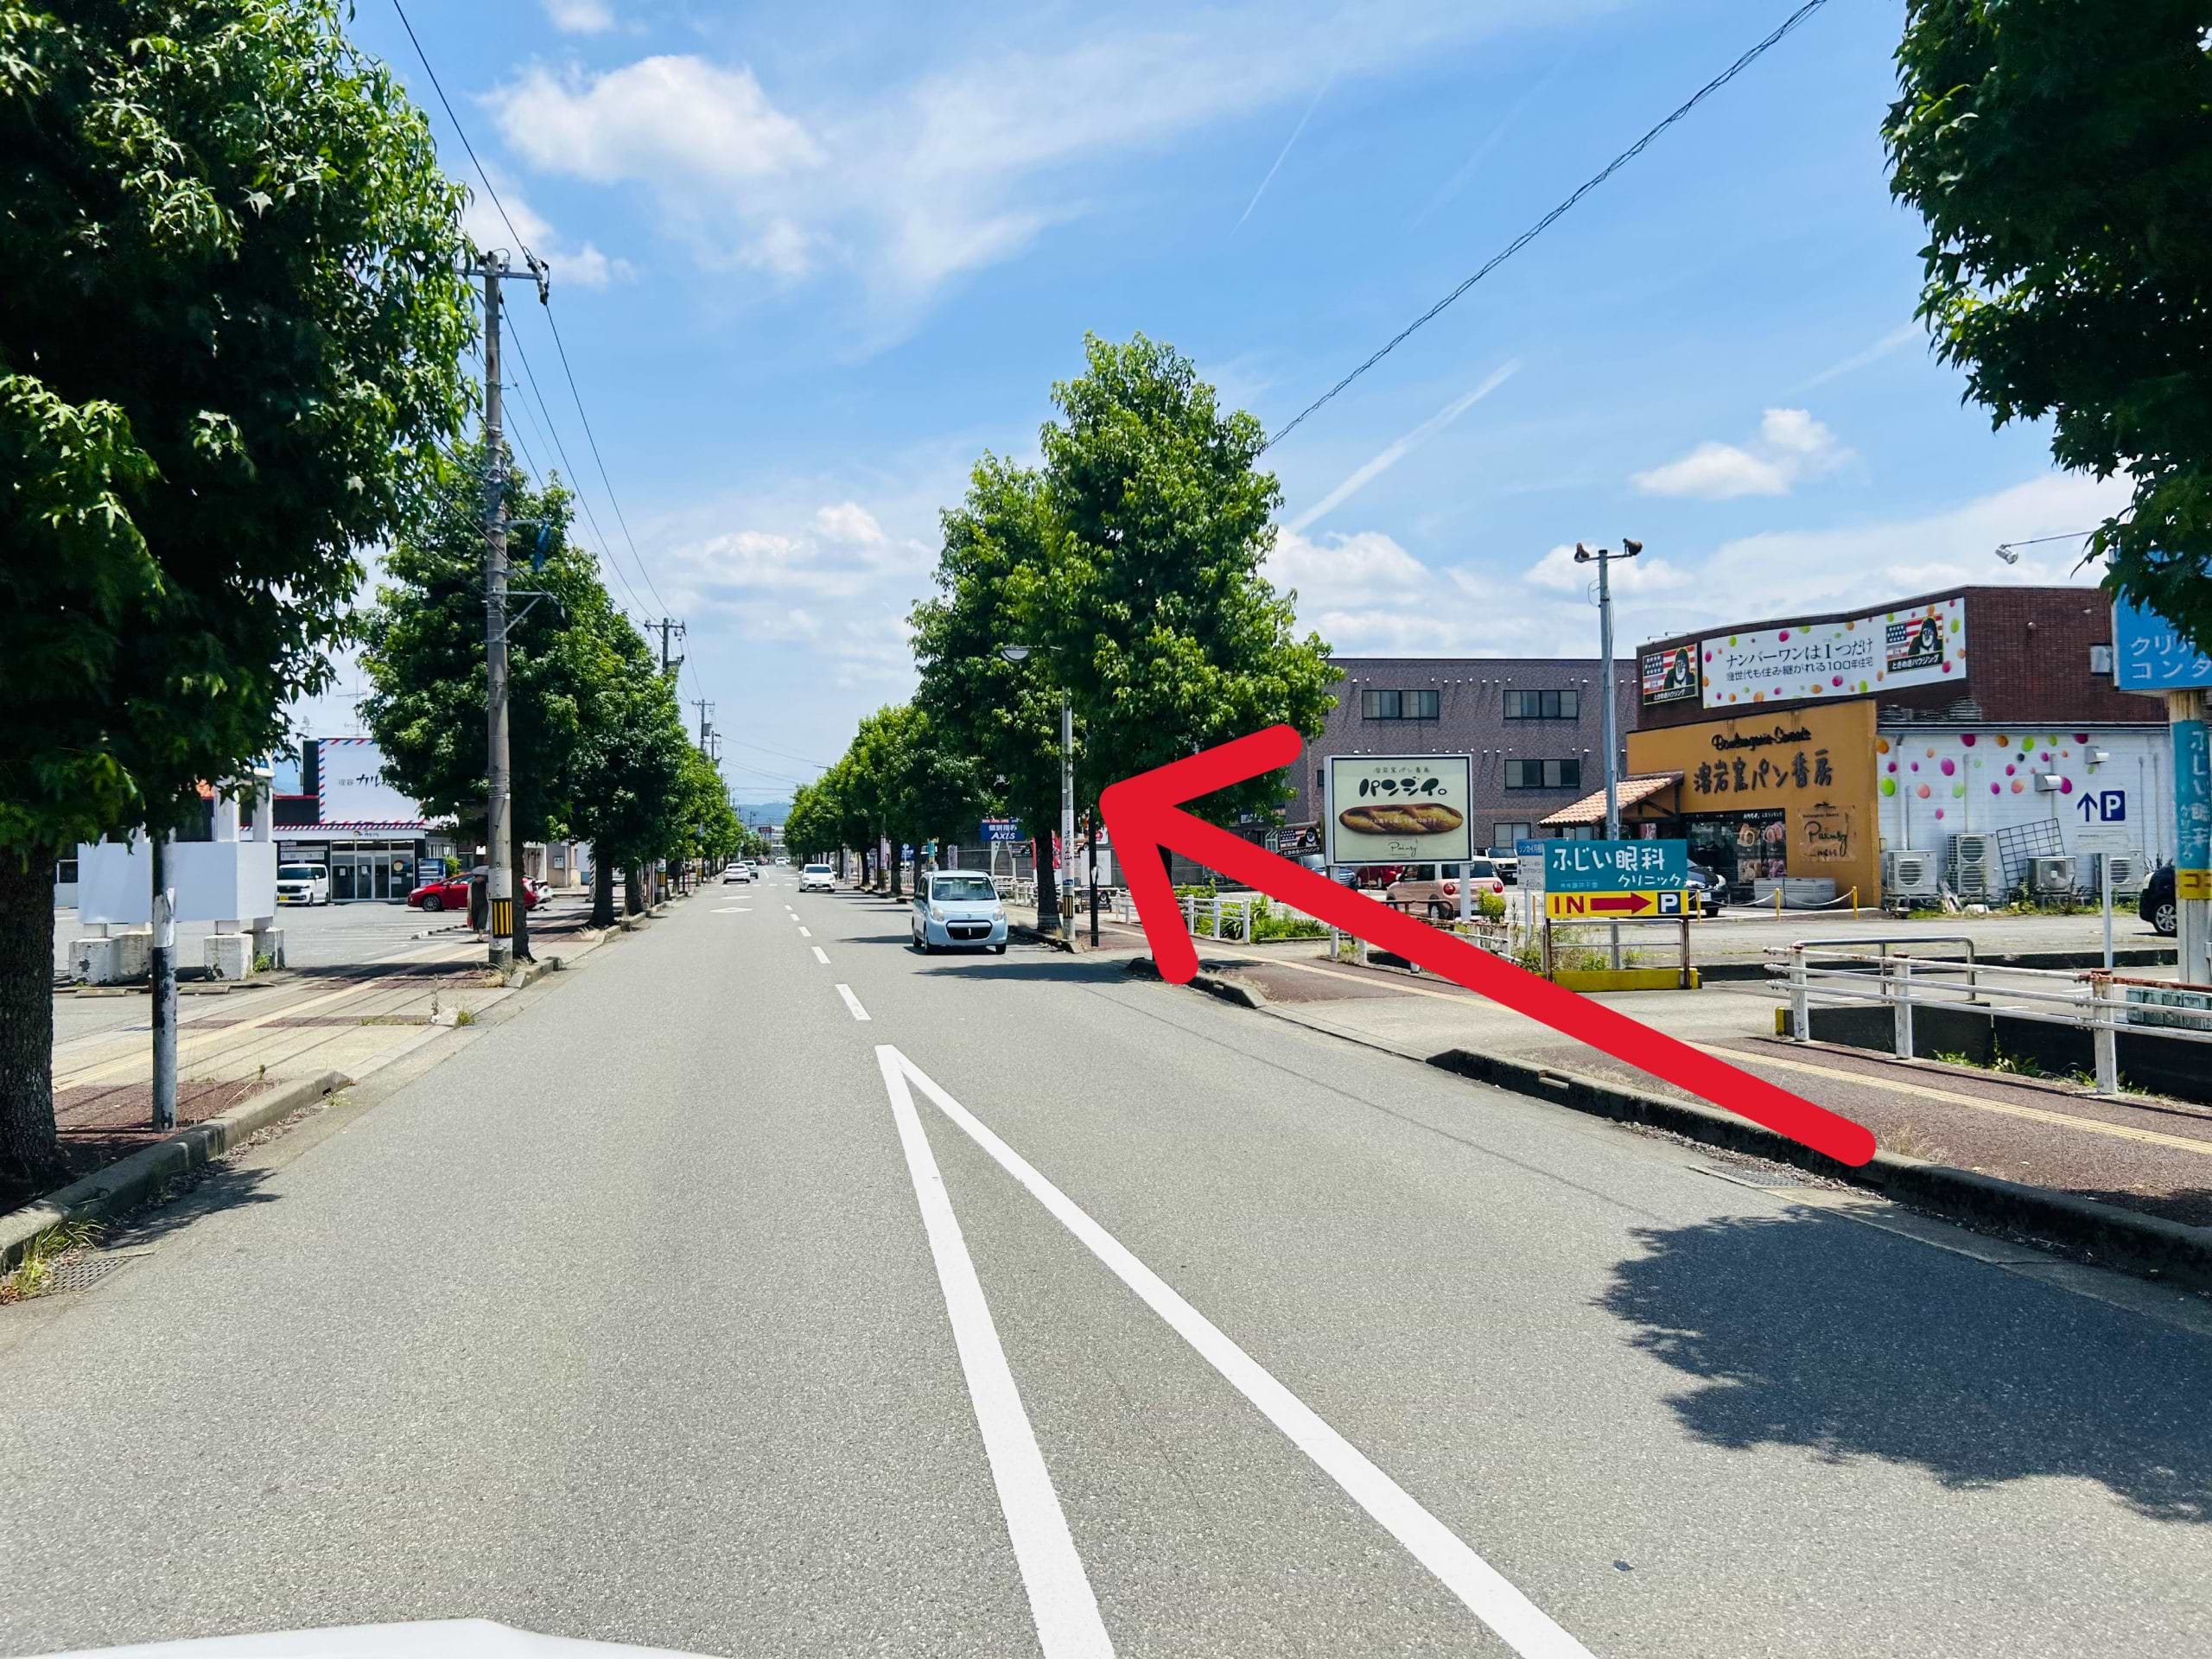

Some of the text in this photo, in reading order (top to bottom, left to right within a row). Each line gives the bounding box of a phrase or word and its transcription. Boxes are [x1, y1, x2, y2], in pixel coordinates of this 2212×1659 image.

[1552, 846, 1665, 871] ふじい眼科
[1618, 873, 1681, 887] クリニック
[1554, 895, 1584, 914] IN
